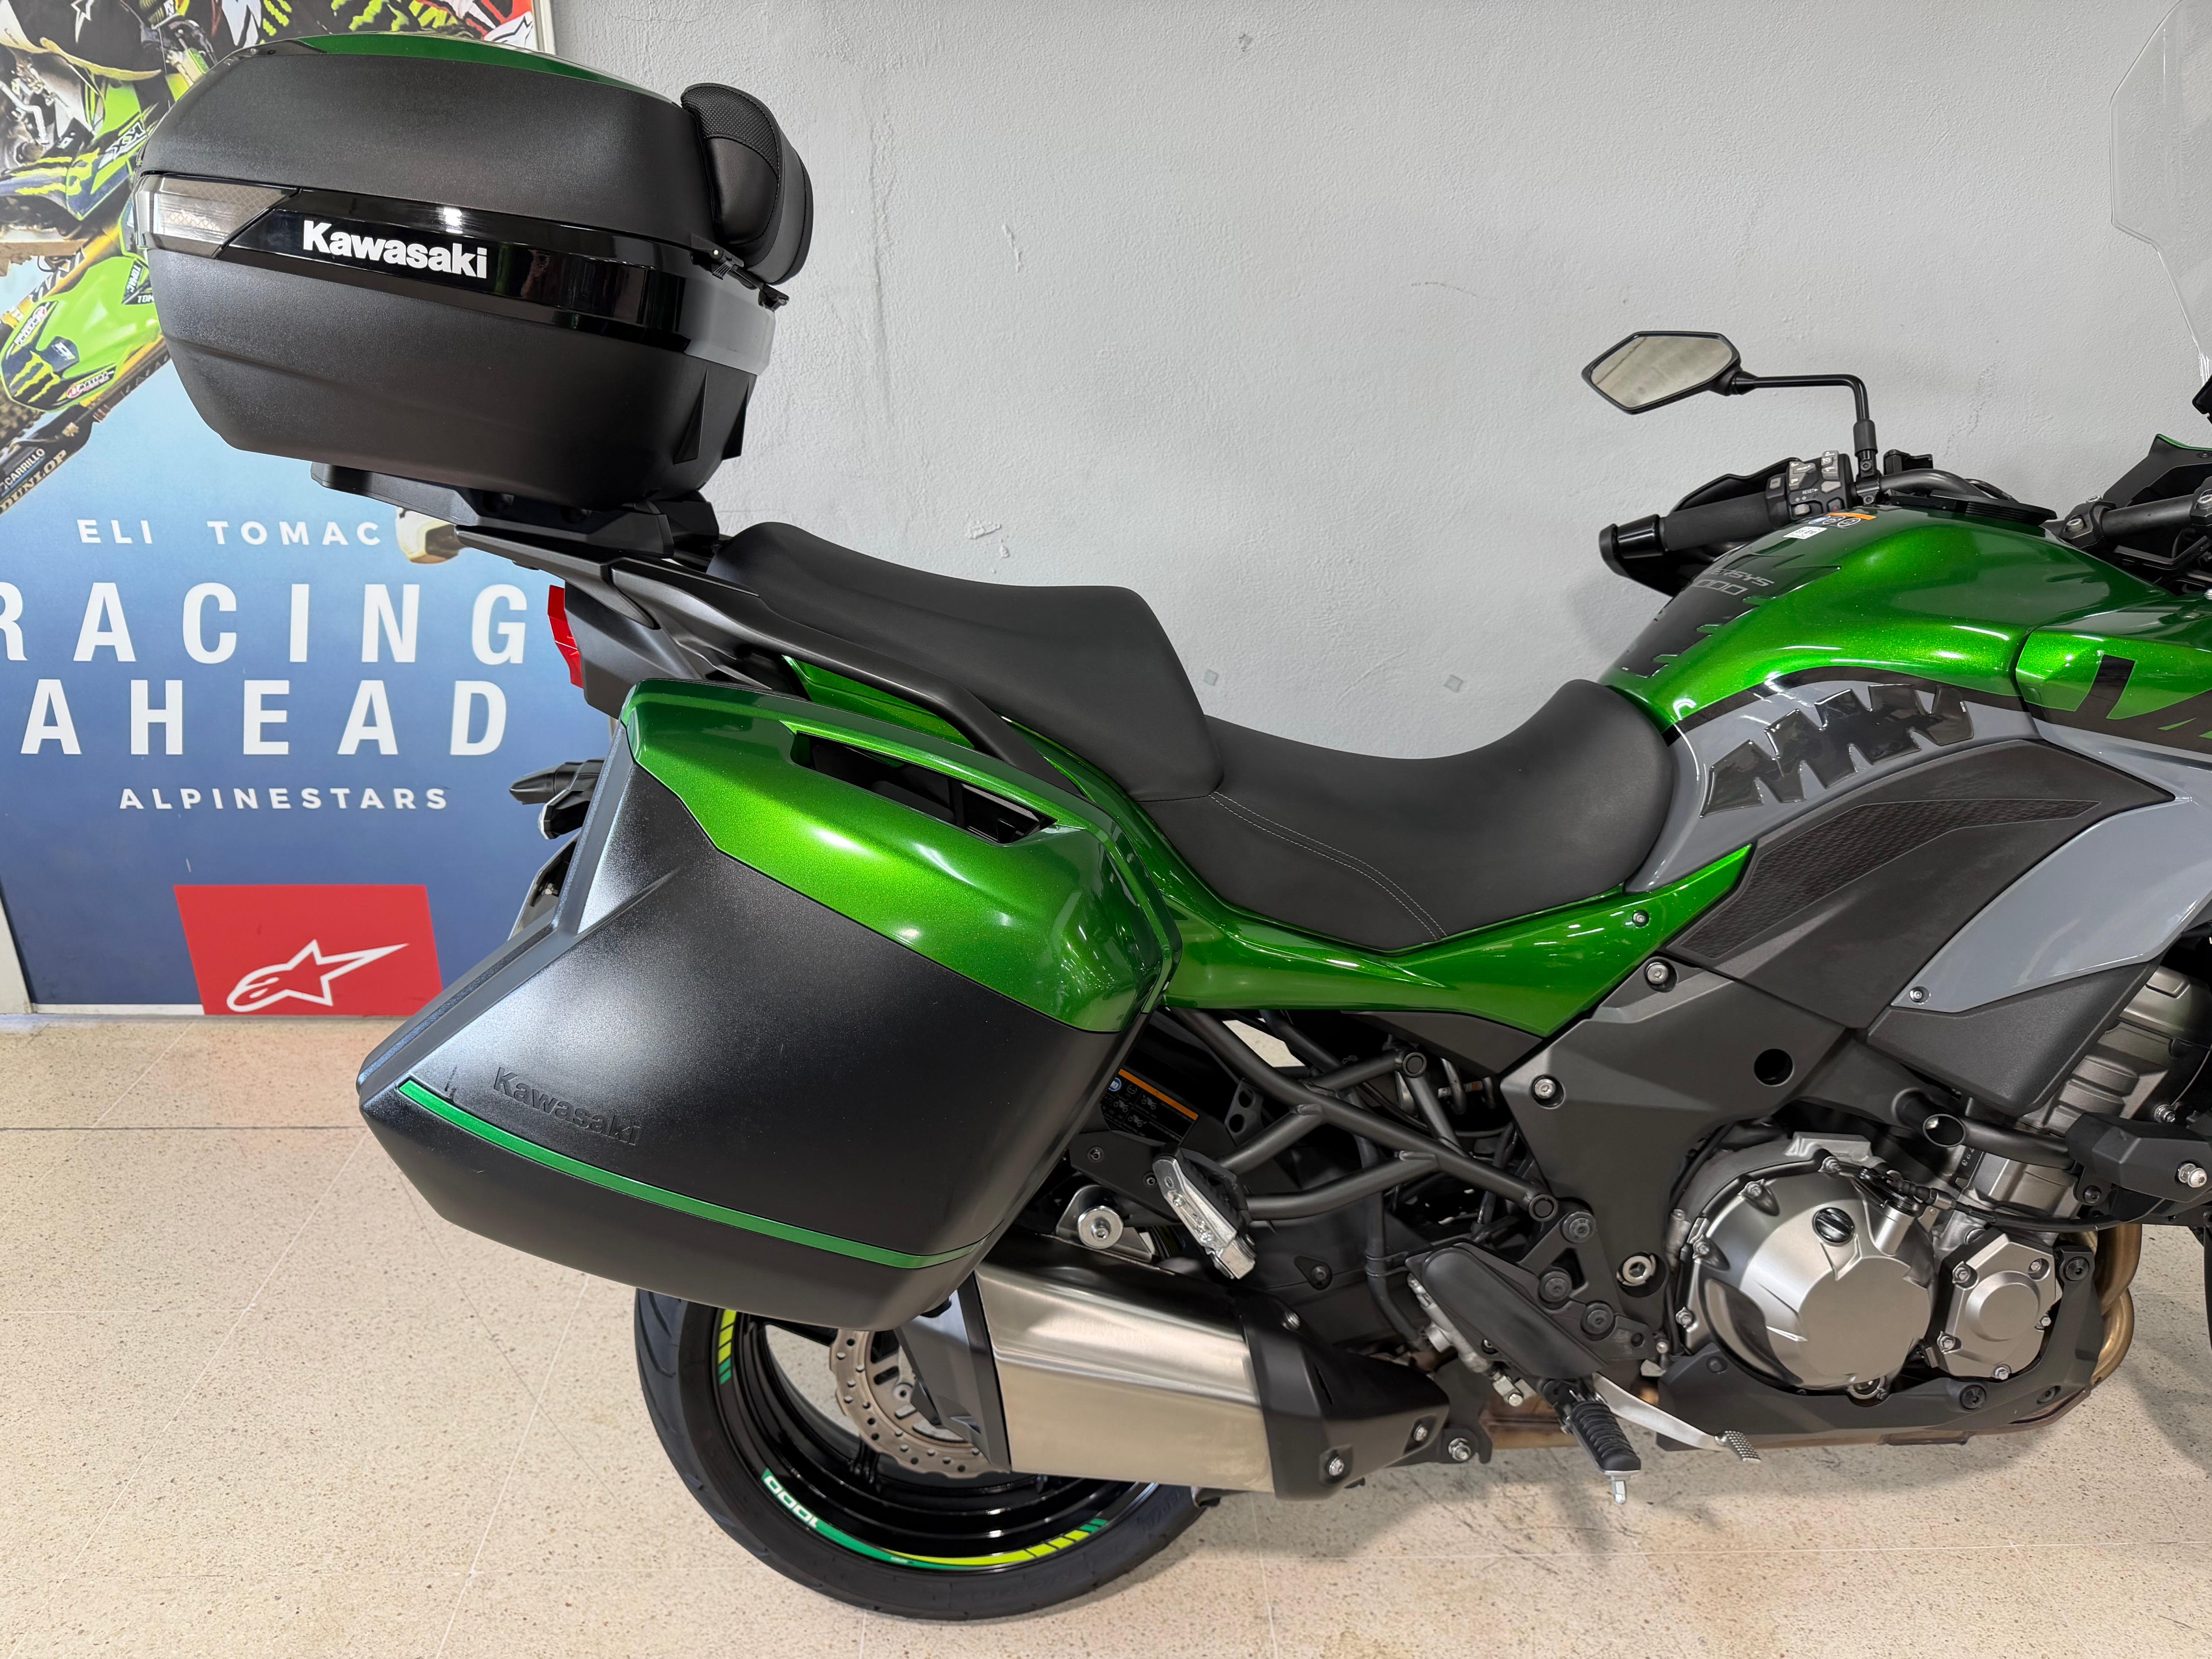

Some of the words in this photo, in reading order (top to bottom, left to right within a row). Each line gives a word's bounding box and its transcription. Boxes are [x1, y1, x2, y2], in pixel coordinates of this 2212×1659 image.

[303, 219, 487, 279] Kawasaki
[0, 449, 67, 512] DUNLOP
[4, 448, 45, 486] CARRILLO
[76, 518, 153, 544] ELI
[207, 520, 381, 546] TOMAC
[20, 679, 507, 756] AHEAD
[119, 788, 448, 810] ALPINESTARS
[493, 1067, 641, 1146] Kawasaki
